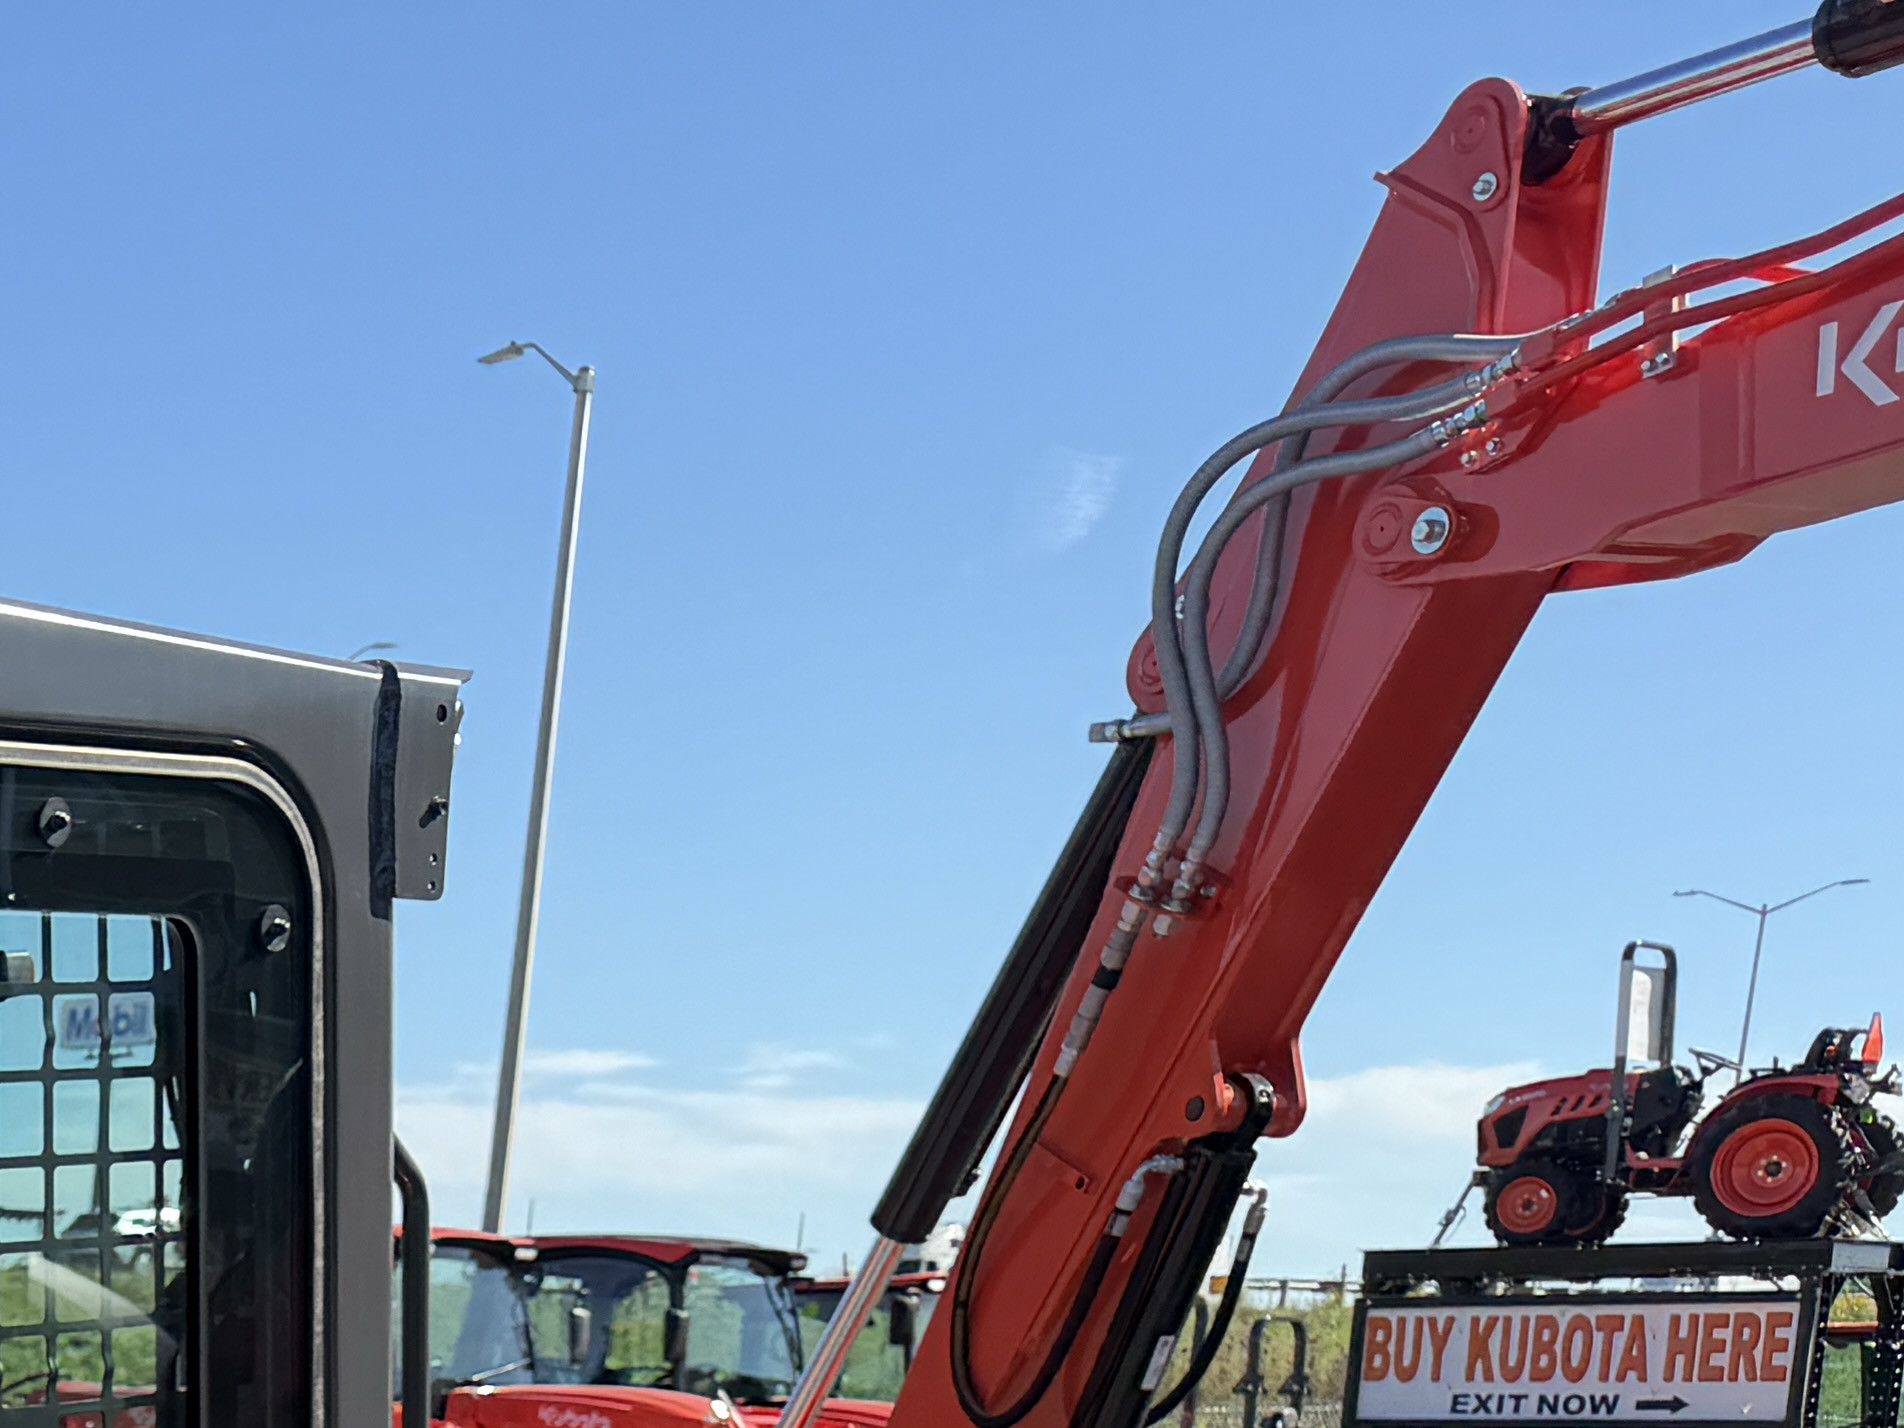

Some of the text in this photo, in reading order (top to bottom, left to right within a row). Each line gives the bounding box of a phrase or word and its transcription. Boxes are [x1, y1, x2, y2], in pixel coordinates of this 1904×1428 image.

[66, 1002, 149, 1041] Mbil
[1363, 1311, 1794, 1384] BUY KUBOTA HERE
[1450, 1393, 1620, 1416] EXIT NOW
